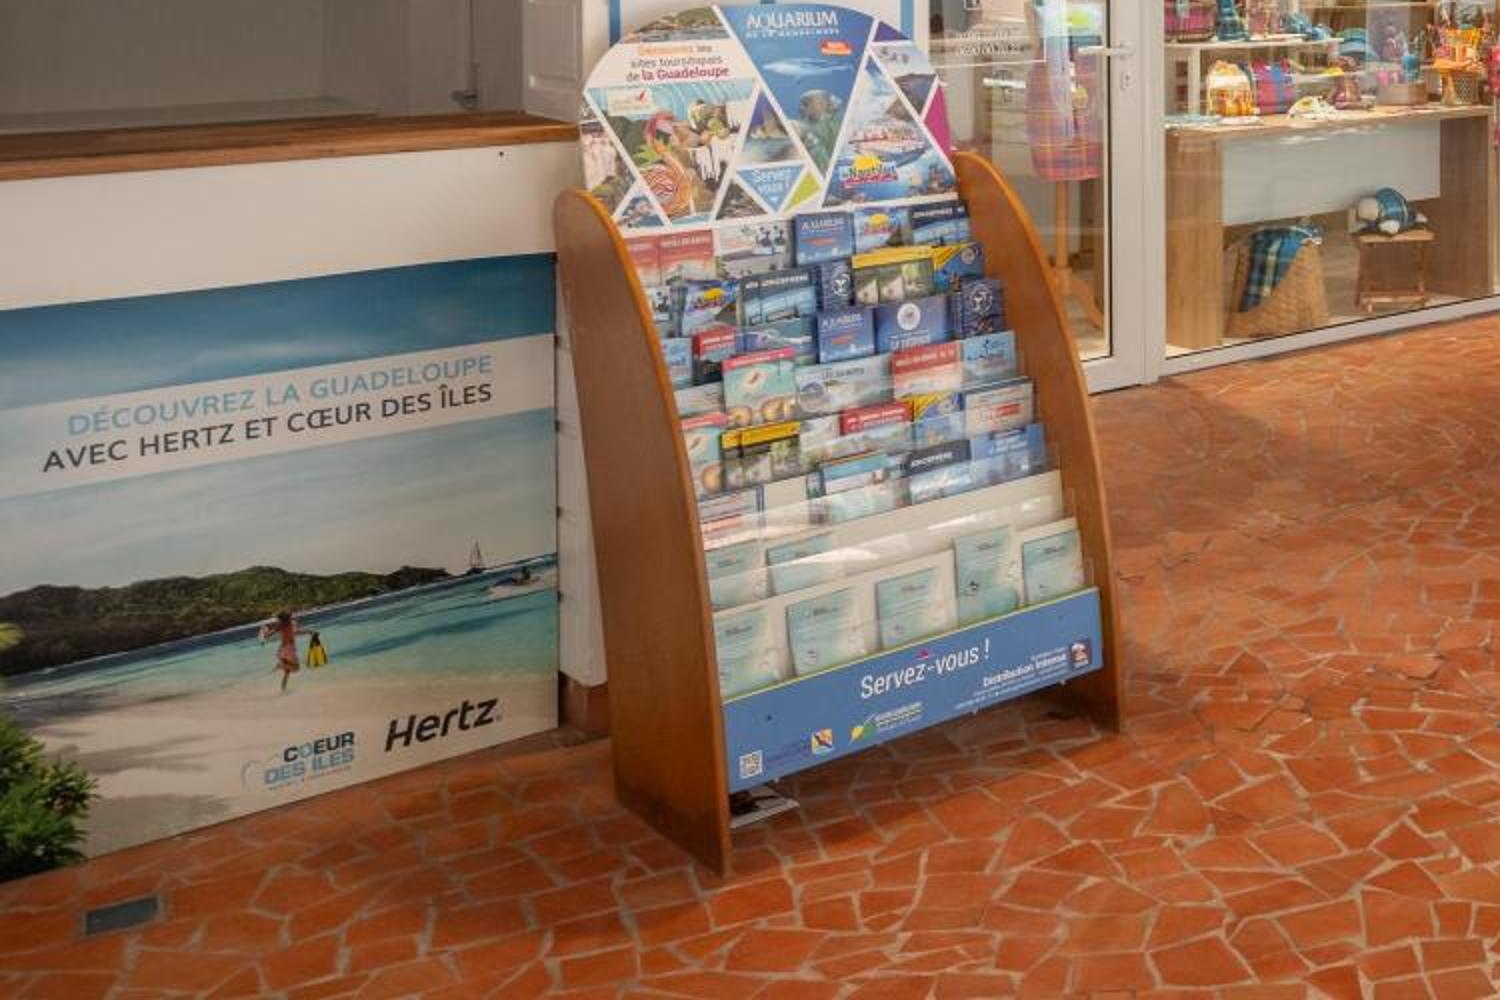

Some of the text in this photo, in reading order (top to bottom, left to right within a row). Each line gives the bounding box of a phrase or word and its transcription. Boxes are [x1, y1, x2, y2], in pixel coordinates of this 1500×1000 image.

[746, 9, 839, 30] AQUARIUM
[626, 66, 729, 82] de la Guadeloupe
[68, 354, 493, 436] DÉCOUVREZ LA GUADELOUPE
[42, 383, 492, 473] AVEC HERTZ ET CŒUR DES ÎLES
[860, 646, 980, 699] Servez-vous
[984, 636, 991, 660] !
[283, 731, 355, 763] COEUR
[384, 697, 499, 752] Hertz
[263, 761, 306, 785] DES
[312, 750, 355, 774] ILES
